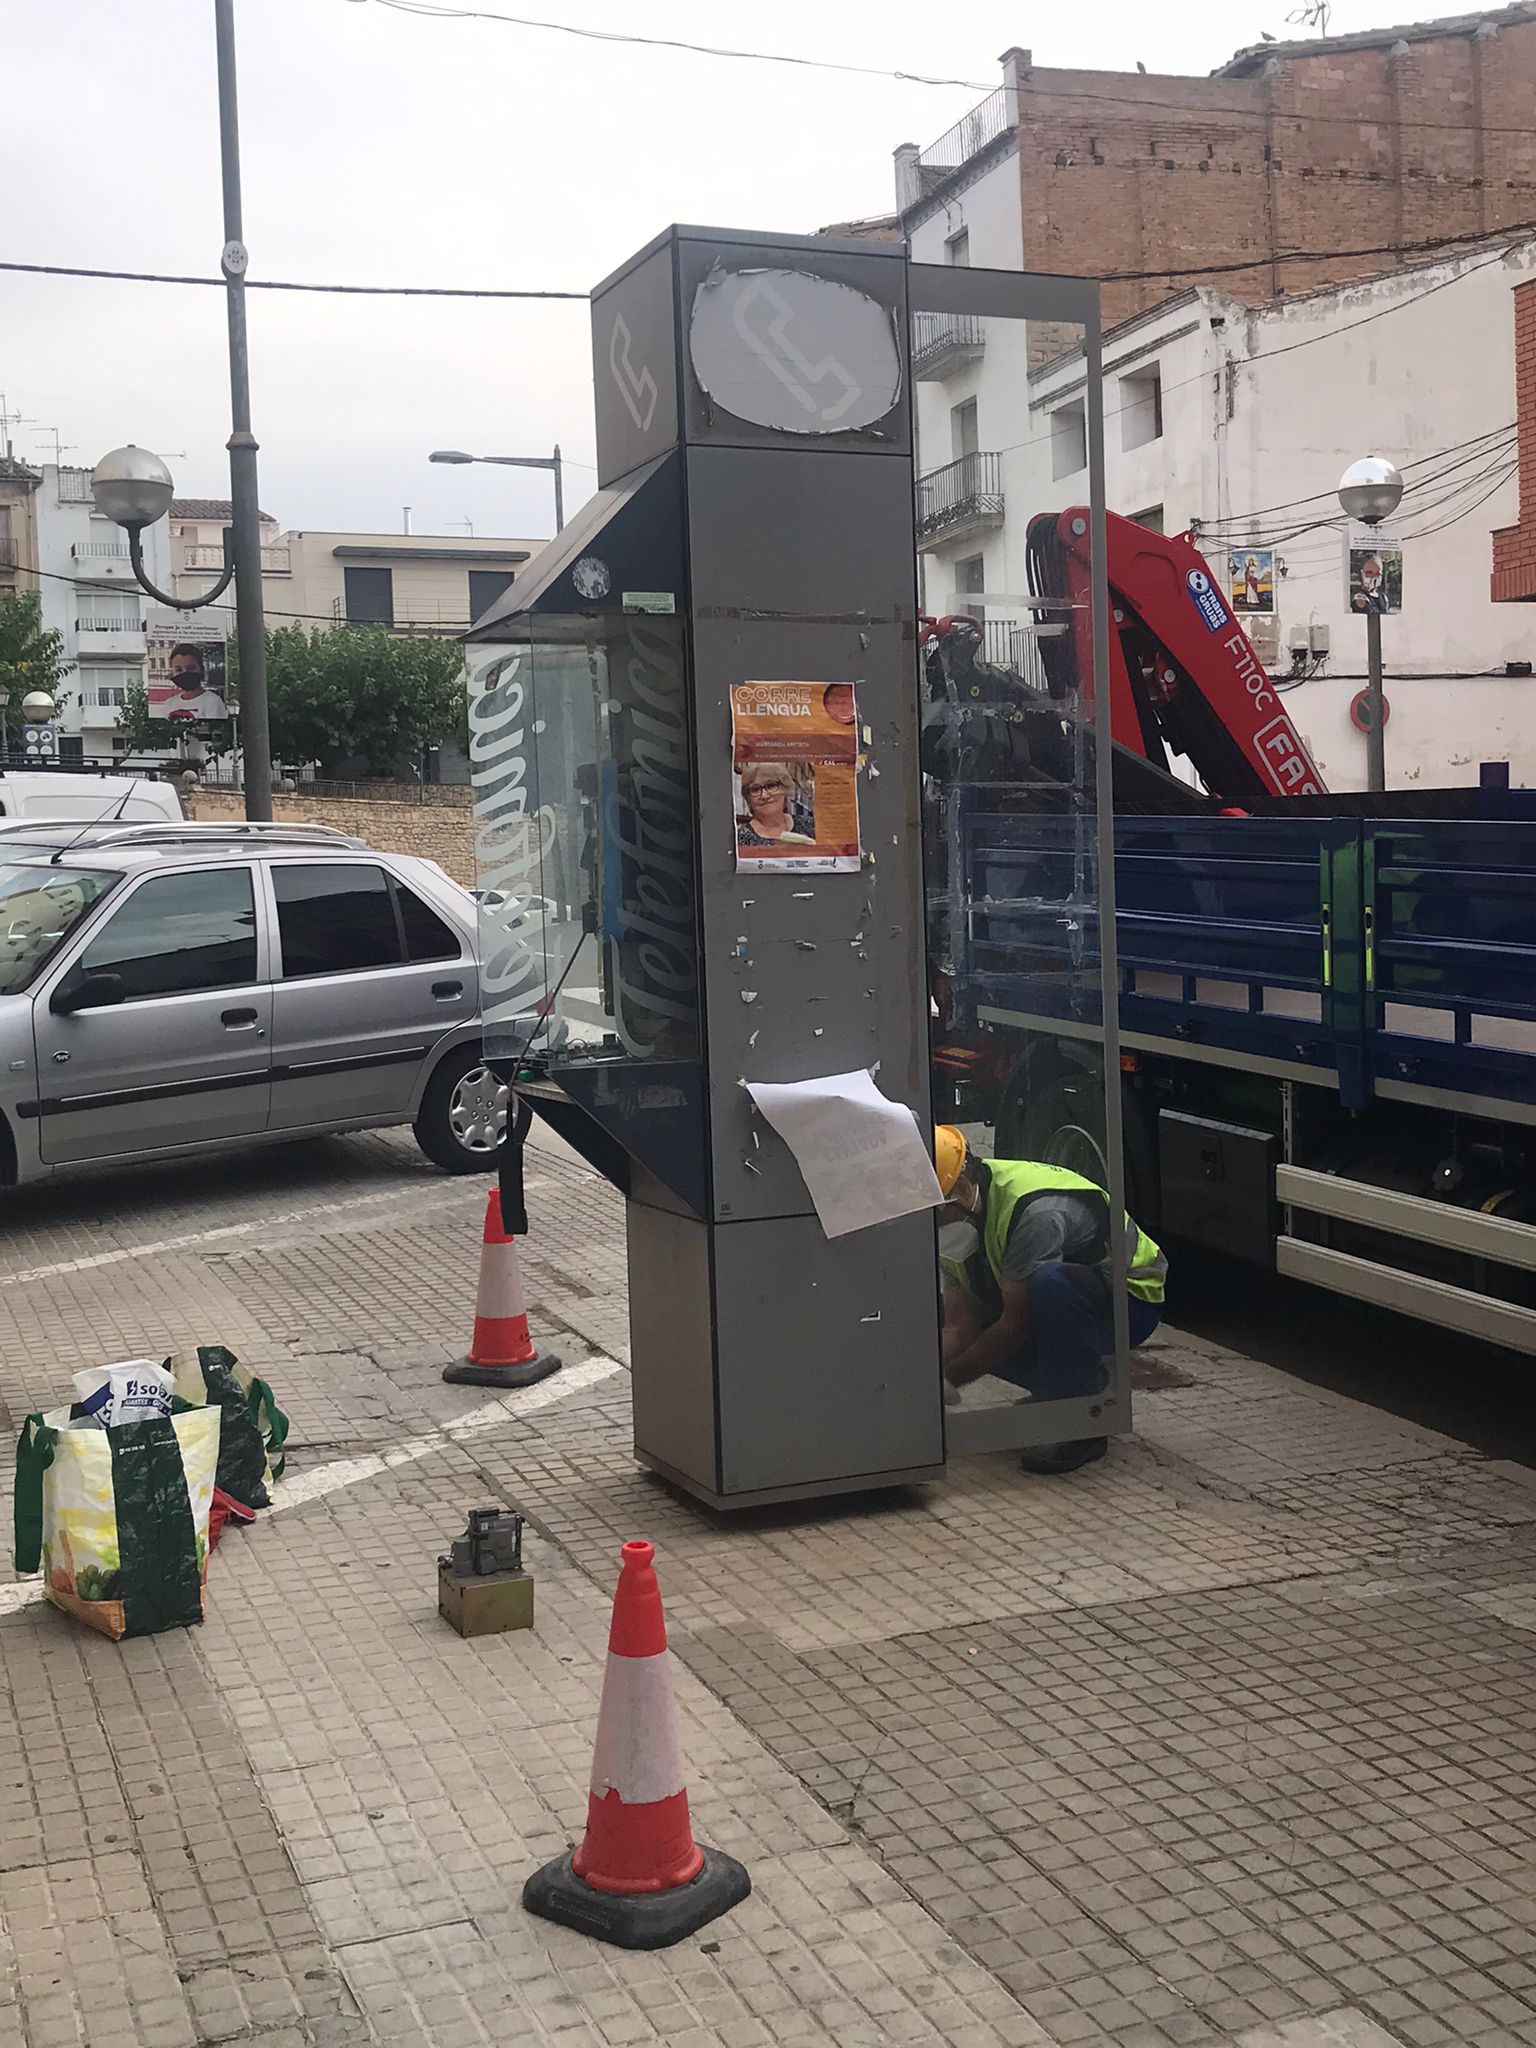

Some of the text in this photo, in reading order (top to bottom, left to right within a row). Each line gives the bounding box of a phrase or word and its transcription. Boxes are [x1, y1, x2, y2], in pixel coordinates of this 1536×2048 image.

[1224, 634, 1274, 712] F110C
[735, 685, 811, 703] CORRE
[736, 703, 811, 716] LLENGUA
